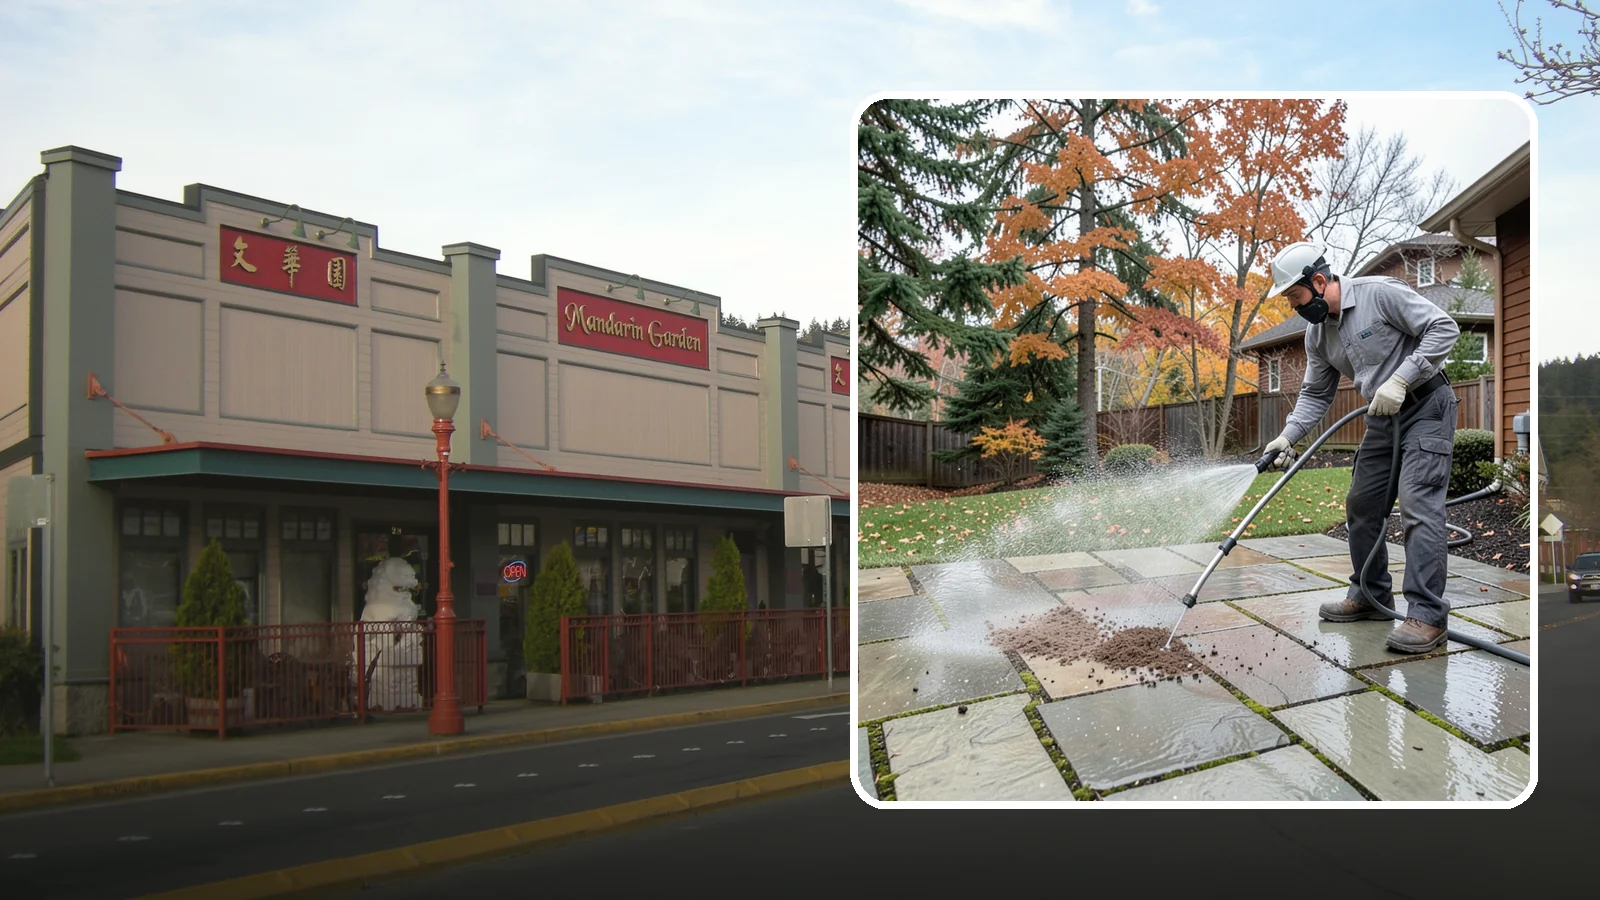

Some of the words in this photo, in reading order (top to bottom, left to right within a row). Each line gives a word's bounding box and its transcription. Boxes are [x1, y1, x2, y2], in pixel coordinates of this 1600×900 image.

[231, 236, 346, 291] 文華園
[564, 302, 644, 341] Mandarin
[648, 320, 702, 352] Garden
[503, 565, 527, 578] OPEN
